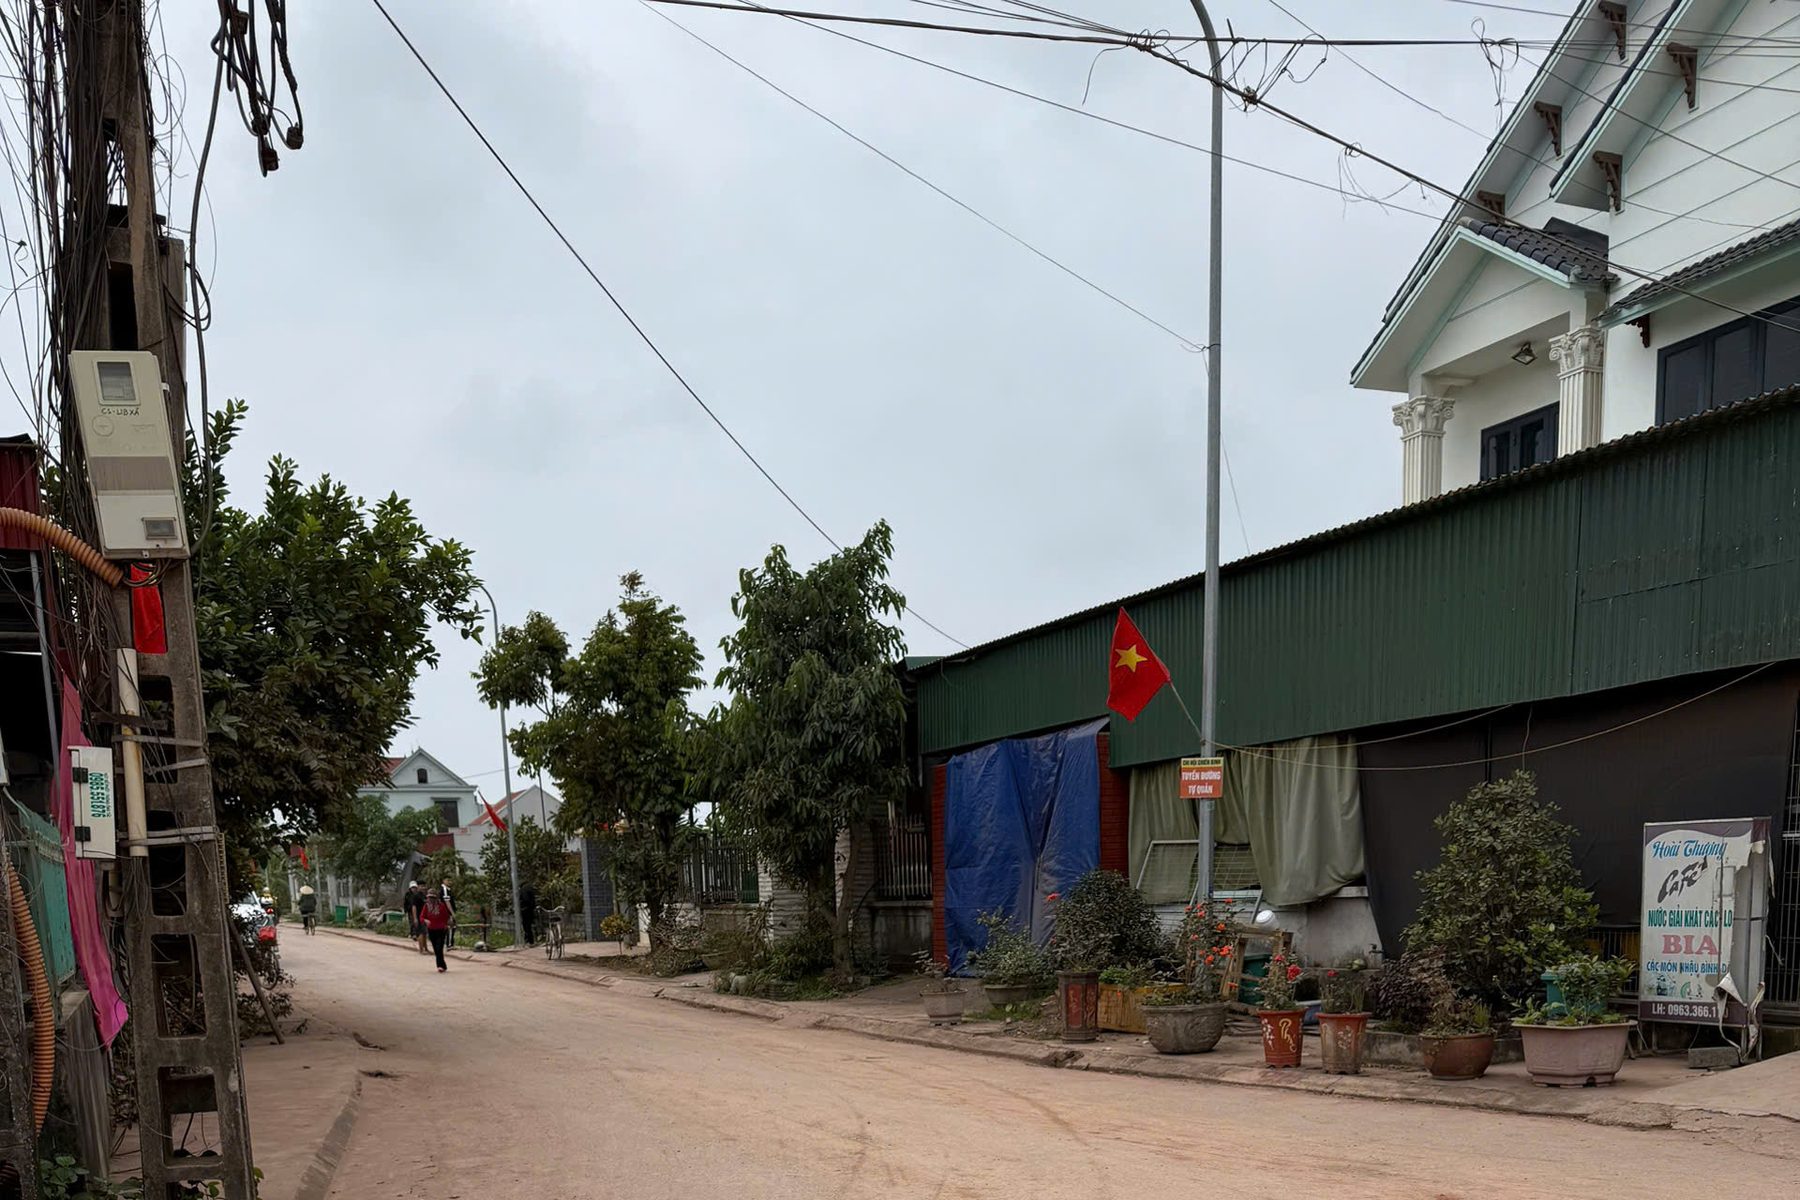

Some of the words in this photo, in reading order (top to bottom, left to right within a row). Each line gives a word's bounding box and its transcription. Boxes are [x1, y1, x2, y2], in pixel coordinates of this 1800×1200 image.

[1652, 840, 1681, 859] Hoài
[1648, 906, 1667, 928] NƯỚC
[1668, 903, 1683, 928] GIẢI
[1684, 906, 1703, 928] KHÁT
[1704, 906, 1719, 928] CÁC
[1662, 934, 1720, 955] BIA
[1646, 959, 1659, 972] CÁC
[1660, 960, 1678, 973] MÓN
[1679, 960, 1699, 977] NHẬU
[1652, 1003, 1666, 1015] LH:
